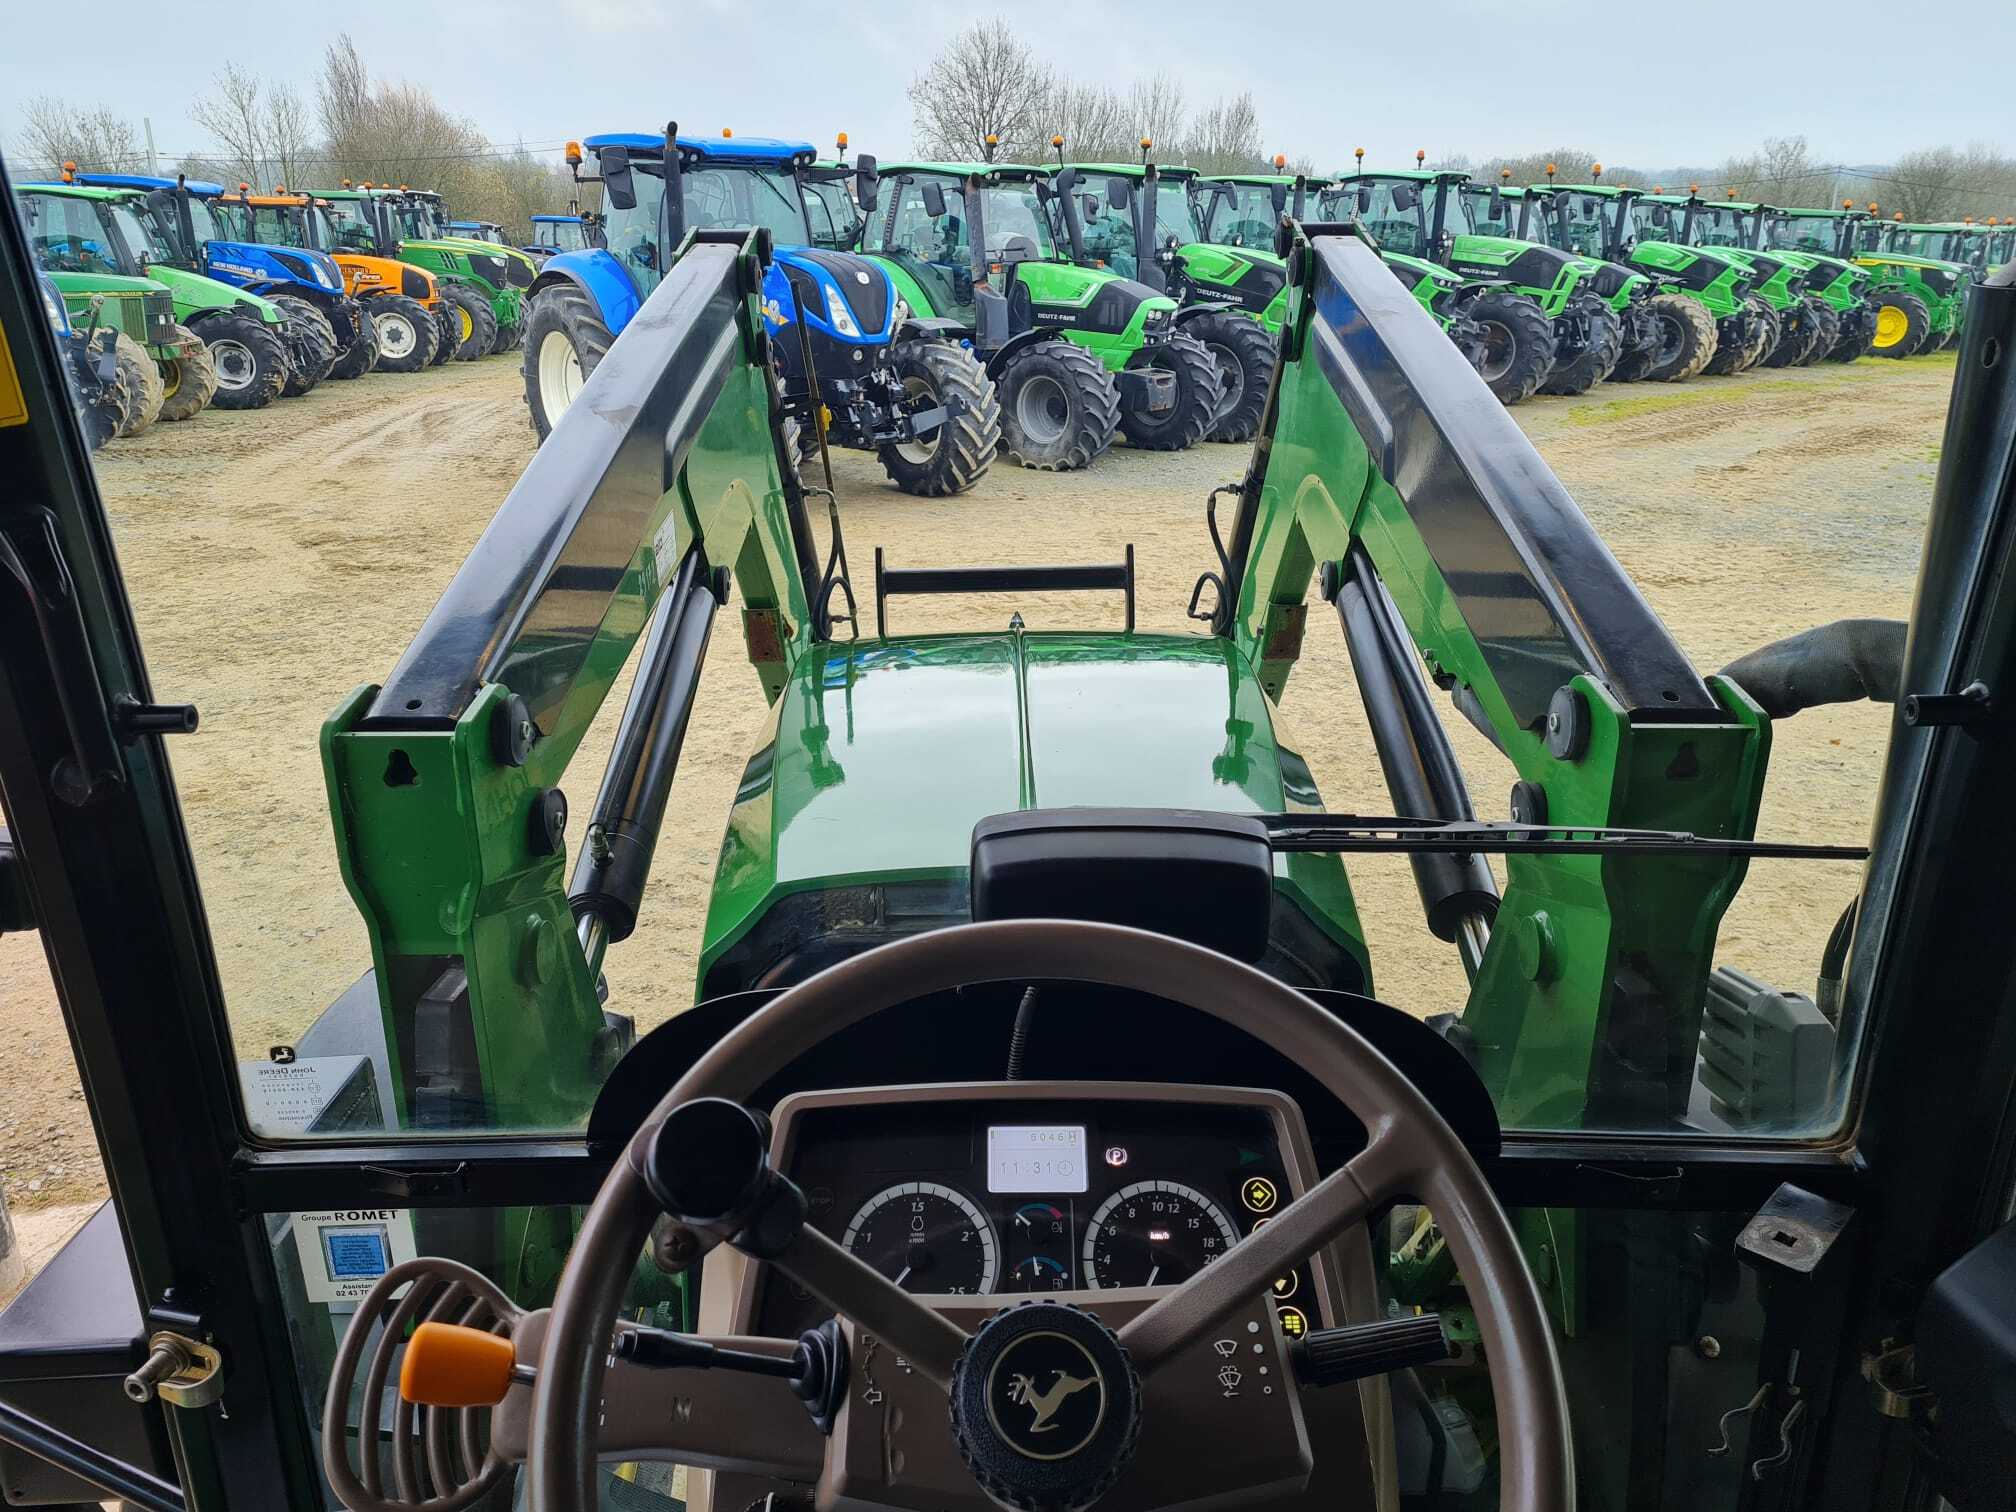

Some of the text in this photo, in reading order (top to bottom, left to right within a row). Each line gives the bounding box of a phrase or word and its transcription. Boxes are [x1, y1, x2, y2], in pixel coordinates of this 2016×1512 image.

[1196, 287, 1243, 303] DEUTZ-FAHR
[1037, 312, 1076, 321] DEUTZ-FAHR
[1151, 1201, 1164, 1212] 10
[1167, 1203, 1180, 1214] 12
[301, 1210, 398, 1222] Groupe ROMET
[1128, 1207, 1136, 1219] 8
[1187, 1218, 1200, 1229] 15
[961, 1231, 970, 1242] 2
[1108, 1225, 1117, 1237] 6
[1149, 1231, 1170, 1240] km/h
[1202, 1238, 1215, 1248] 18
[1103, 1254, 1111, 1265] 4
